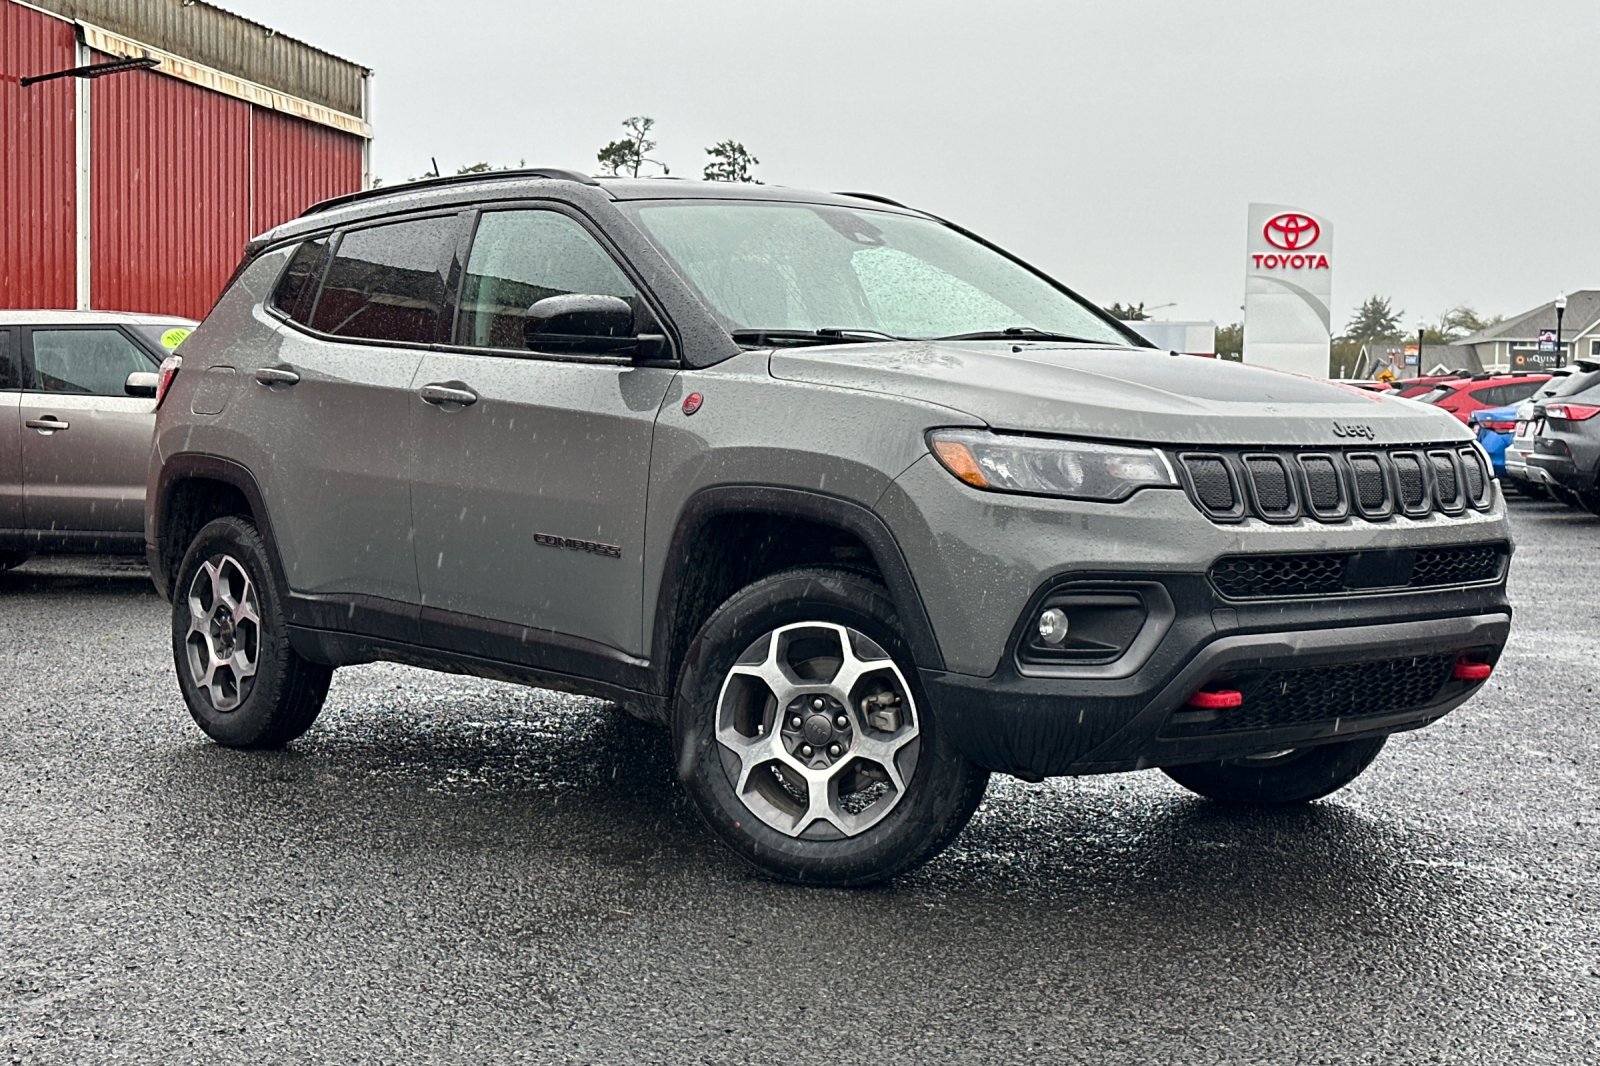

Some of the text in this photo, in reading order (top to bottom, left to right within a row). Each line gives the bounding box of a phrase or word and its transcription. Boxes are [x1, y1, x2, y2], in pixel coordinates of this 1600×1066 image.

[1252, 254, 1329, 269] TOYOTA
[1532, 354, 1565, 364] QUINA
[1332, 421, 1375, 441] Jeep
[533, 532, 621, 558] COMPASS
